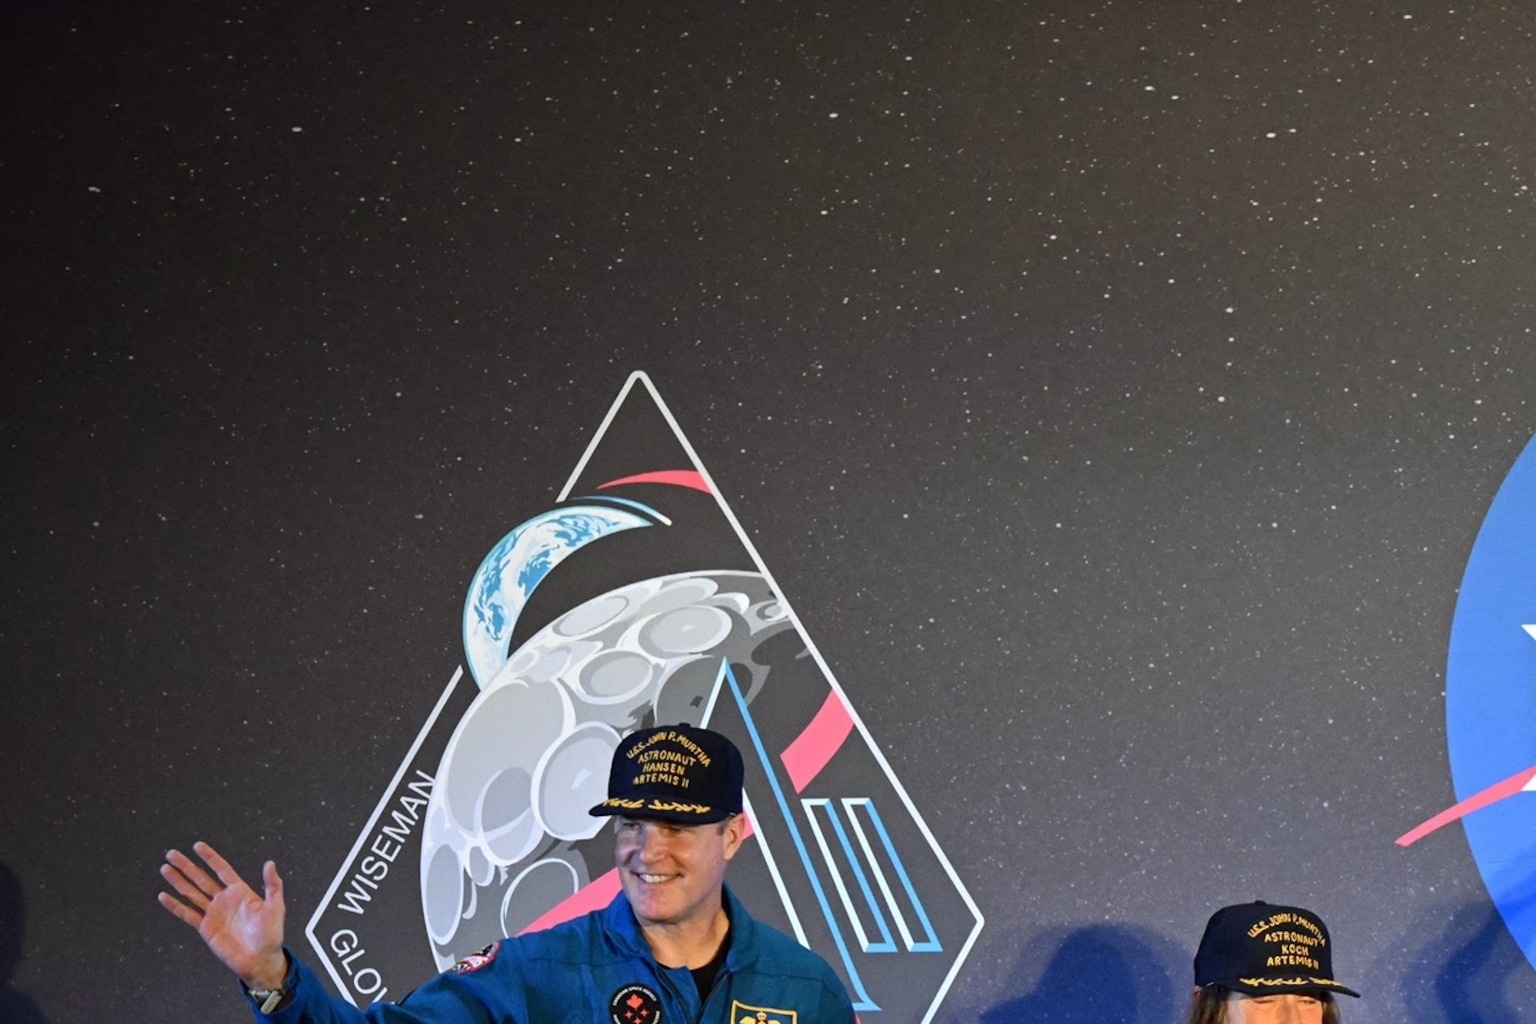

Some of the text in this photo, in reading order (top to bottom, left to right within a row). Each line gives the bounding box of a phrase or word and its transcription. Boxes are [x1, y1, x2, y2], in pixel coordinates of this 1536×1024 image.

[638, 750, 697, 767] ASTRONAUT
[643, 762, 685, 776] HANSEN
[633, 773, 690, 789] ARTEMIS II
[337, 769, 436, 915] WISEMAN
[1269, 913, 1291, 927] JOHN
[1264, 931, 1319, 947] ASTRONAUT
[1282, 944, 1309, 956] KOCH
[1267, 956, 1312, 967] ARTEMIS
